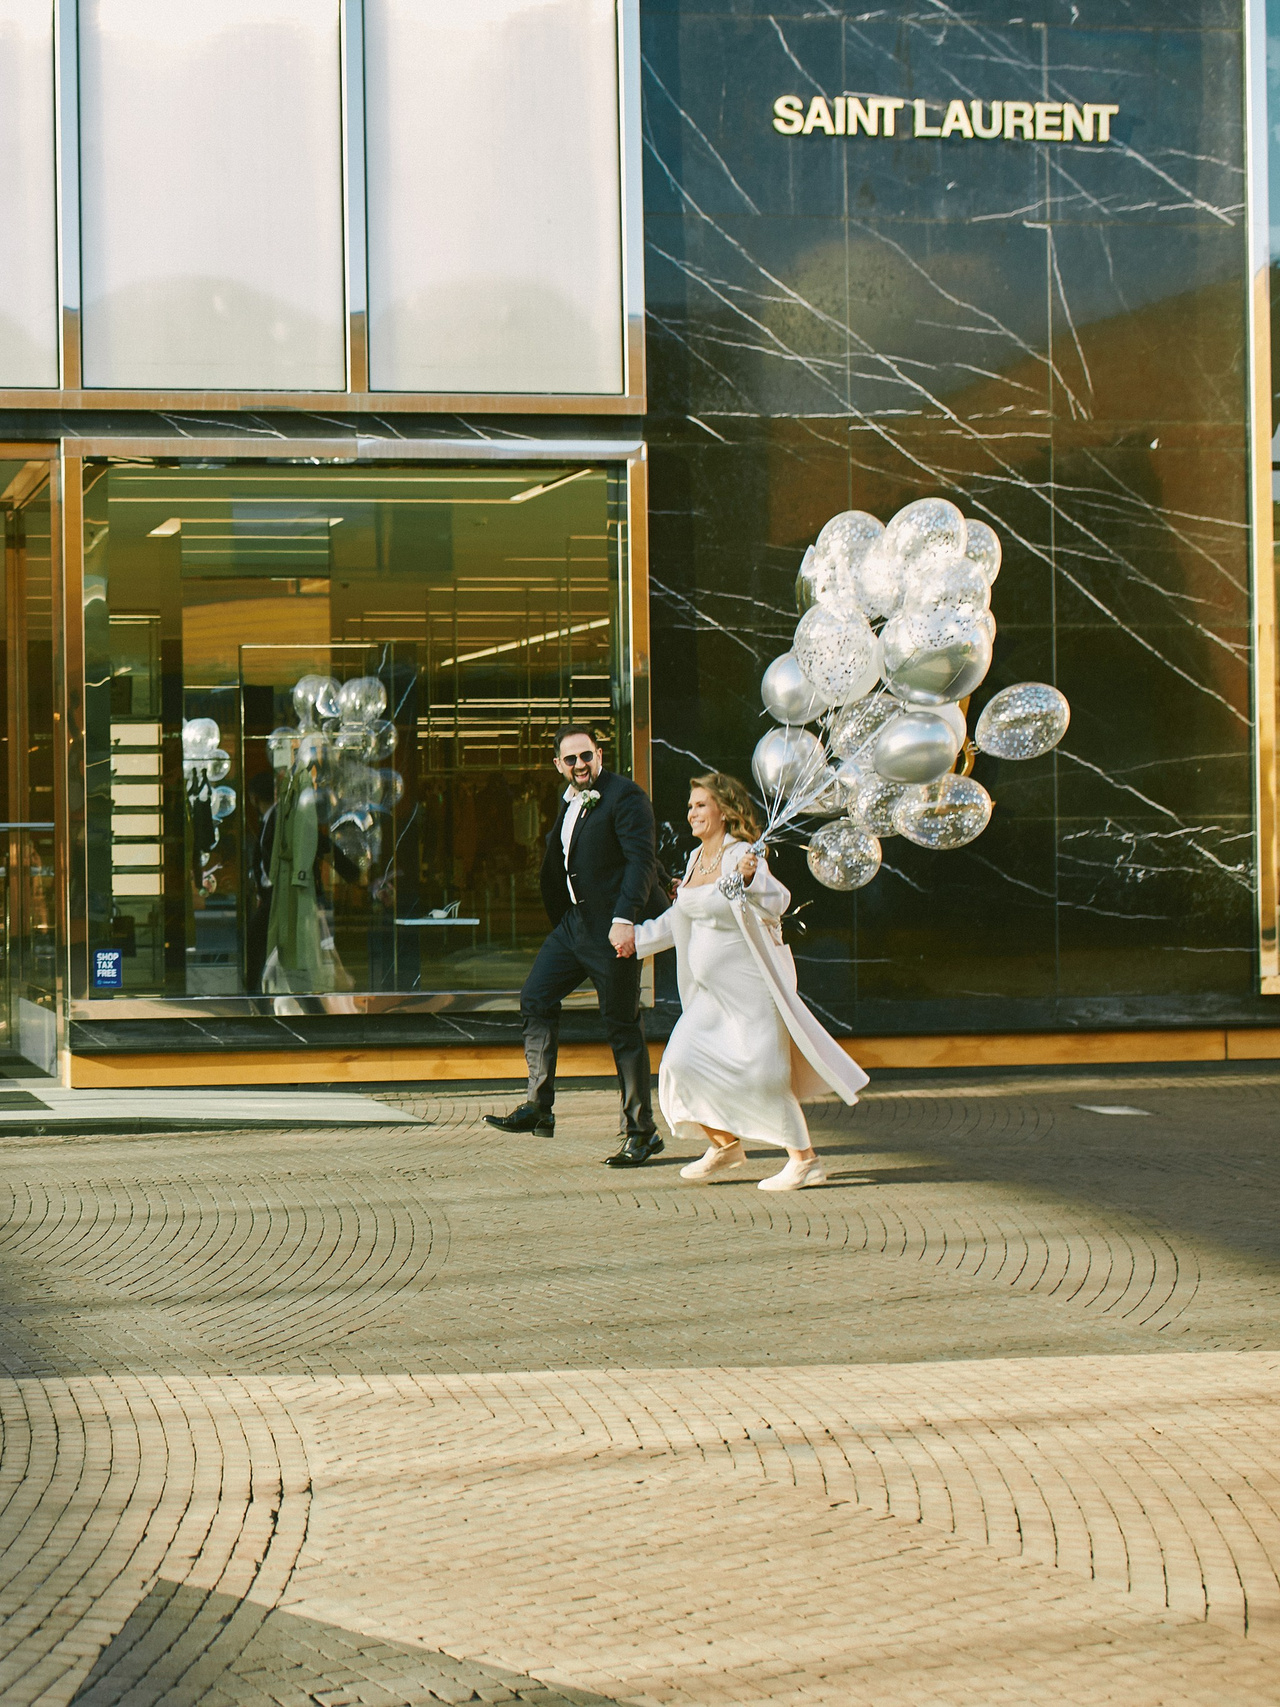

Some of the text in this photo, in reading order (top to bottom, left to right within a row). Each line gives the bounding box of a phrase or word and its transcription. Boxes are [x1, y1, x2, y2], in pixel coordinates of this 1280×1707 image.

[772, 95, 1120, 143] SAINT LAURENT
[97, 952, 119, 960] SHOP
[97, 961, 113, 969] TAX
[97, 969, 117, 977] FREE
